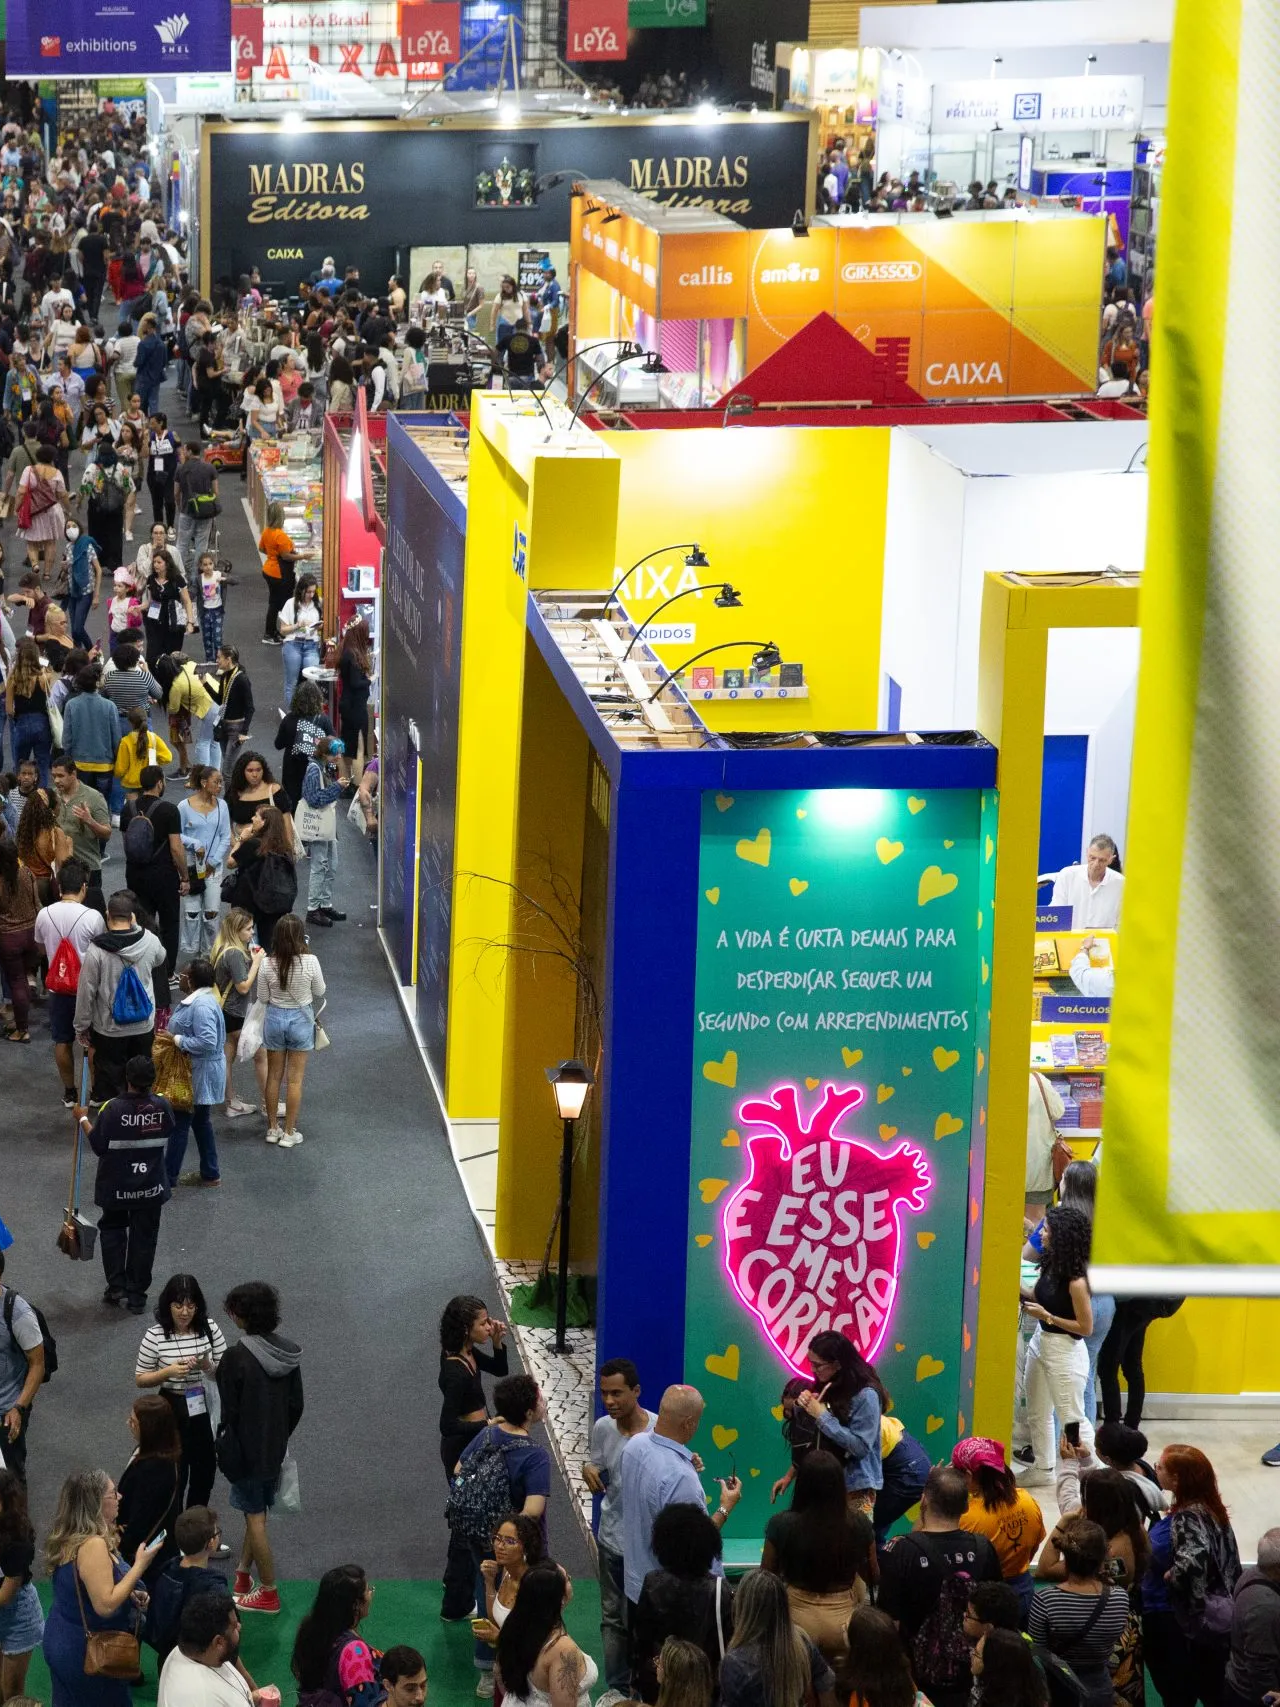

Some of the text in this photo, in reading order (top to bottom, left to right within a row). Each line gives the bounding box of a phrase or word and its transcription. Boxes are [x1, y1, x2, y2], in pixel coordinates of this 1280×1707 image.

[328, 11, 369, 26] Brasil
[66, 37, 137, 53] exhibitions
[161, 46, 190, 54] SNEL
[233, 35, 257, 59] Ya
[407, 30, 453, 57] LeYa
[573, 25, 619, 52] LeYa
[236, 42, 400, 80] AIXA
[1051, 106, 1084, 120] FREI
[248, 162, 365, 195] MADRAS
[629, 156, 748, 189] MADRAS
[247, 196, 371, 224] Editora
[267, 248, 304, 260] CAIXA
[679, 265, 733, 286] callis
[845, 264, 917, 281] GIRASSOL
[926, 362, 1004, 386] CAIXA
[424, 393, 469, 410] ADRA
[613, 565, 703, 600] AIXA
[1036, 914, 1058, 923] ARÓS
[716, 926, 957, 950] A VIDA É CURTA DEMAIS PARA
[737, 969, 932, 995] DESPERDIÇAR SEQUER UM
[698, 1010, 969, 1032] SEGUNDO COM ARREPENDIMENTOS
[1058, 1004, 1111, 1015] ORÁCULOS
[121, 1111, 165, 1127] SUNSET
[131, 1162, 148, 1174] 76
[792, 1141, 851, 1193] EU
[116, 1183, 165, 1200] LIMPEZA
[727, 1189, 893, 1247] E ESSE
[788, 1238, 868, 1307] MEU
